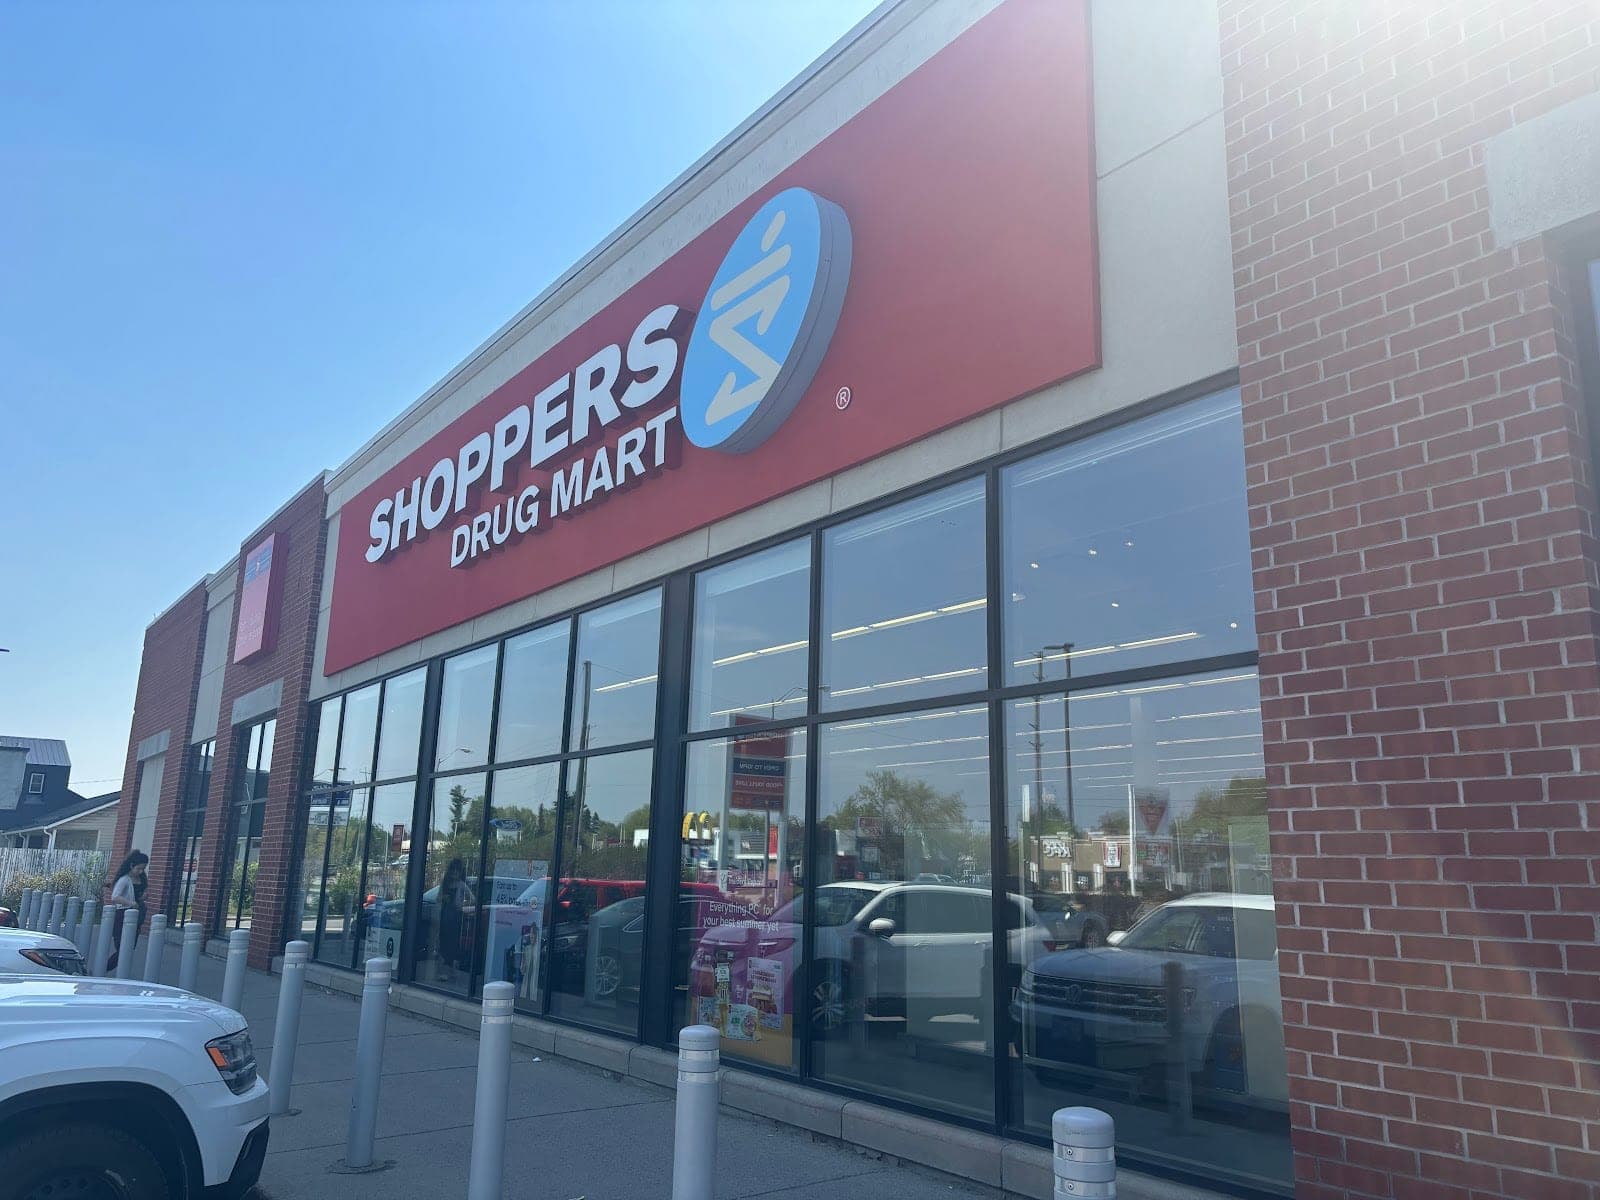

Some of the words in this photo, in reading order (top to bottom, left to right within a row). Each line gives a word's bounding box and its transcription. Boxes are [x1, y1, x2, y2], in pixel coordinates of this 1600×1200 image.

[365, 304, 679, 563] SHOPPERS
[450, 485, 541, 569] DRUG
[550, 405, 677, 519] MART
[703, 916, 719, 929] your
[719, 917, 735, 928] best
[736, 918, 766, 930] summer
[767, 921, 779, 933] yet
[709, 901, 747, 917] Everything
[763, 904, 774, 916] for
